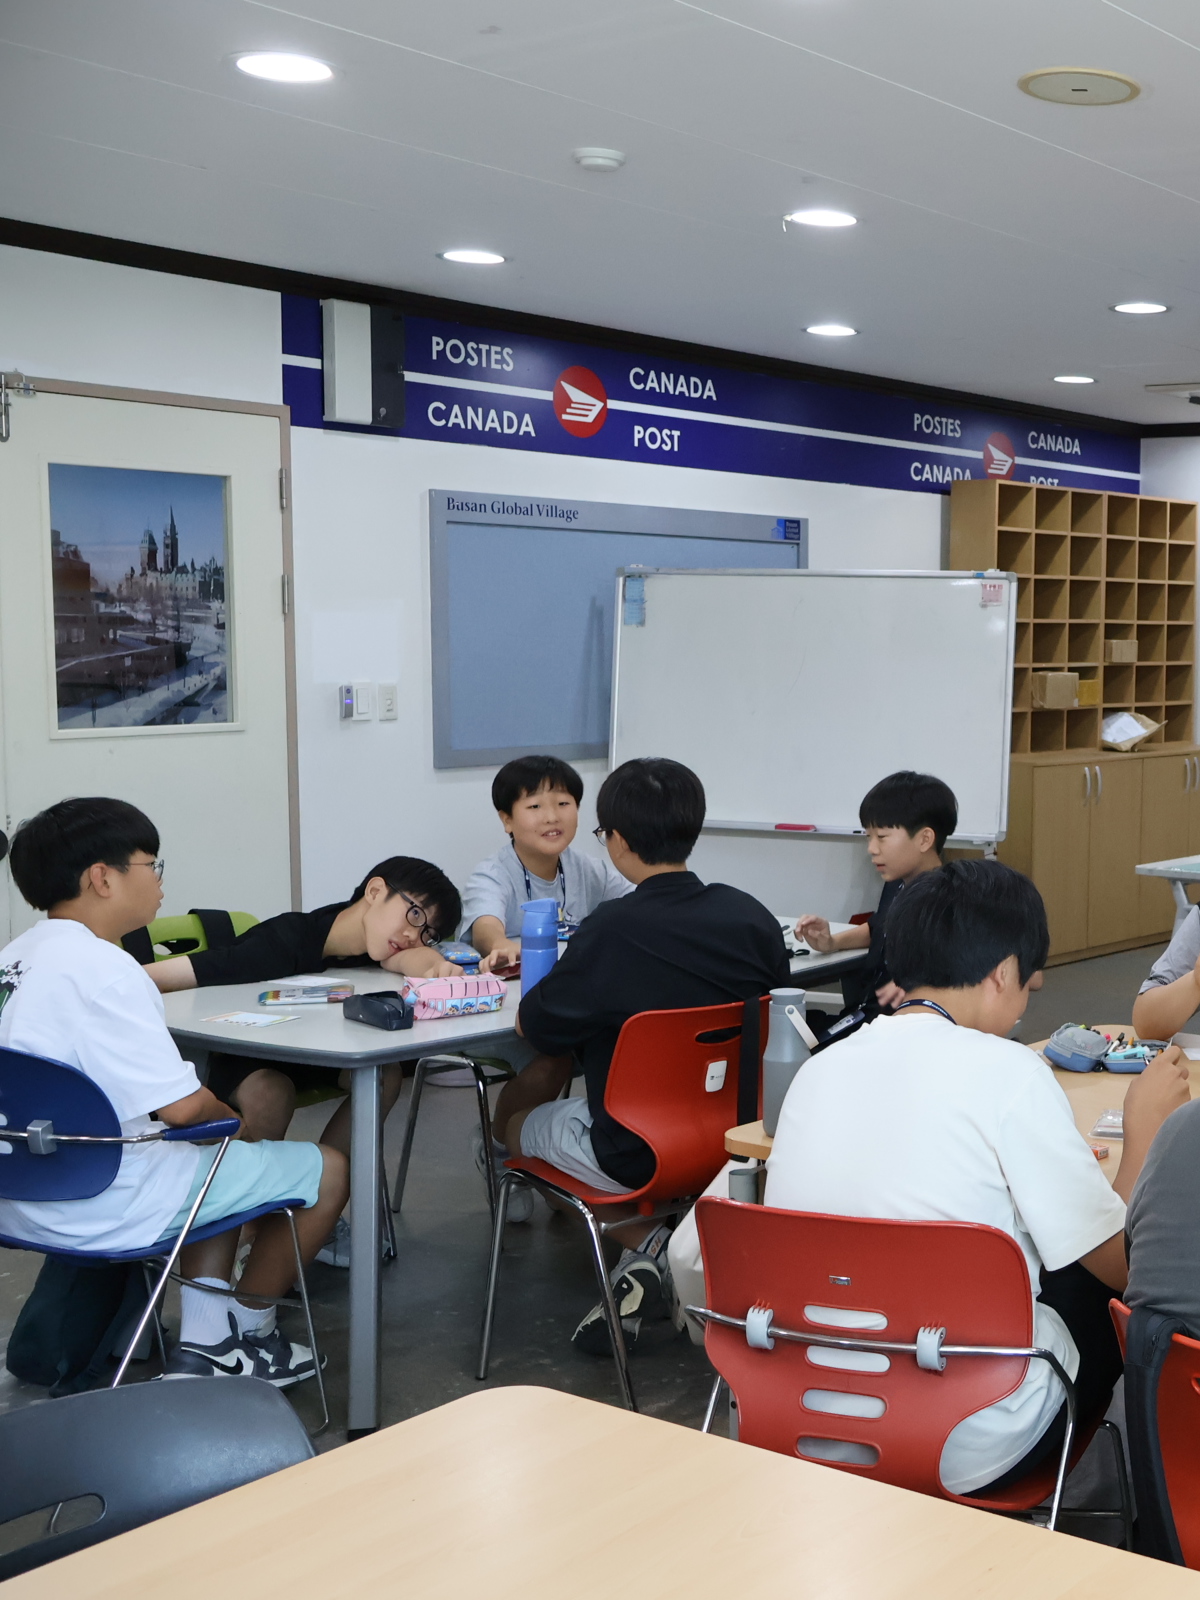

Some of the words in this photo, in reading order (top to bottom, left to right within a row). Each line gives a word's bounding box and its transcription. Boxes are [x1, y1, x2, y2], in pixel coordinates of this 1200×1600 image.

[431, 336, 514, 372] POSTES
[629, 367, 717, 402] CANADA
[427, 402, 536, 438] CANADA
[913, 413, 962, 438] POSTES
[633, 425, 681, 452] POST
[1027, 431, 1082, 456] CANADA
[910, 461, 972, 484] CANADA
[446, 497, 487, 513] Busan
[491, 501, 533, 517] Global
[536, 504, 579, 523] Village
